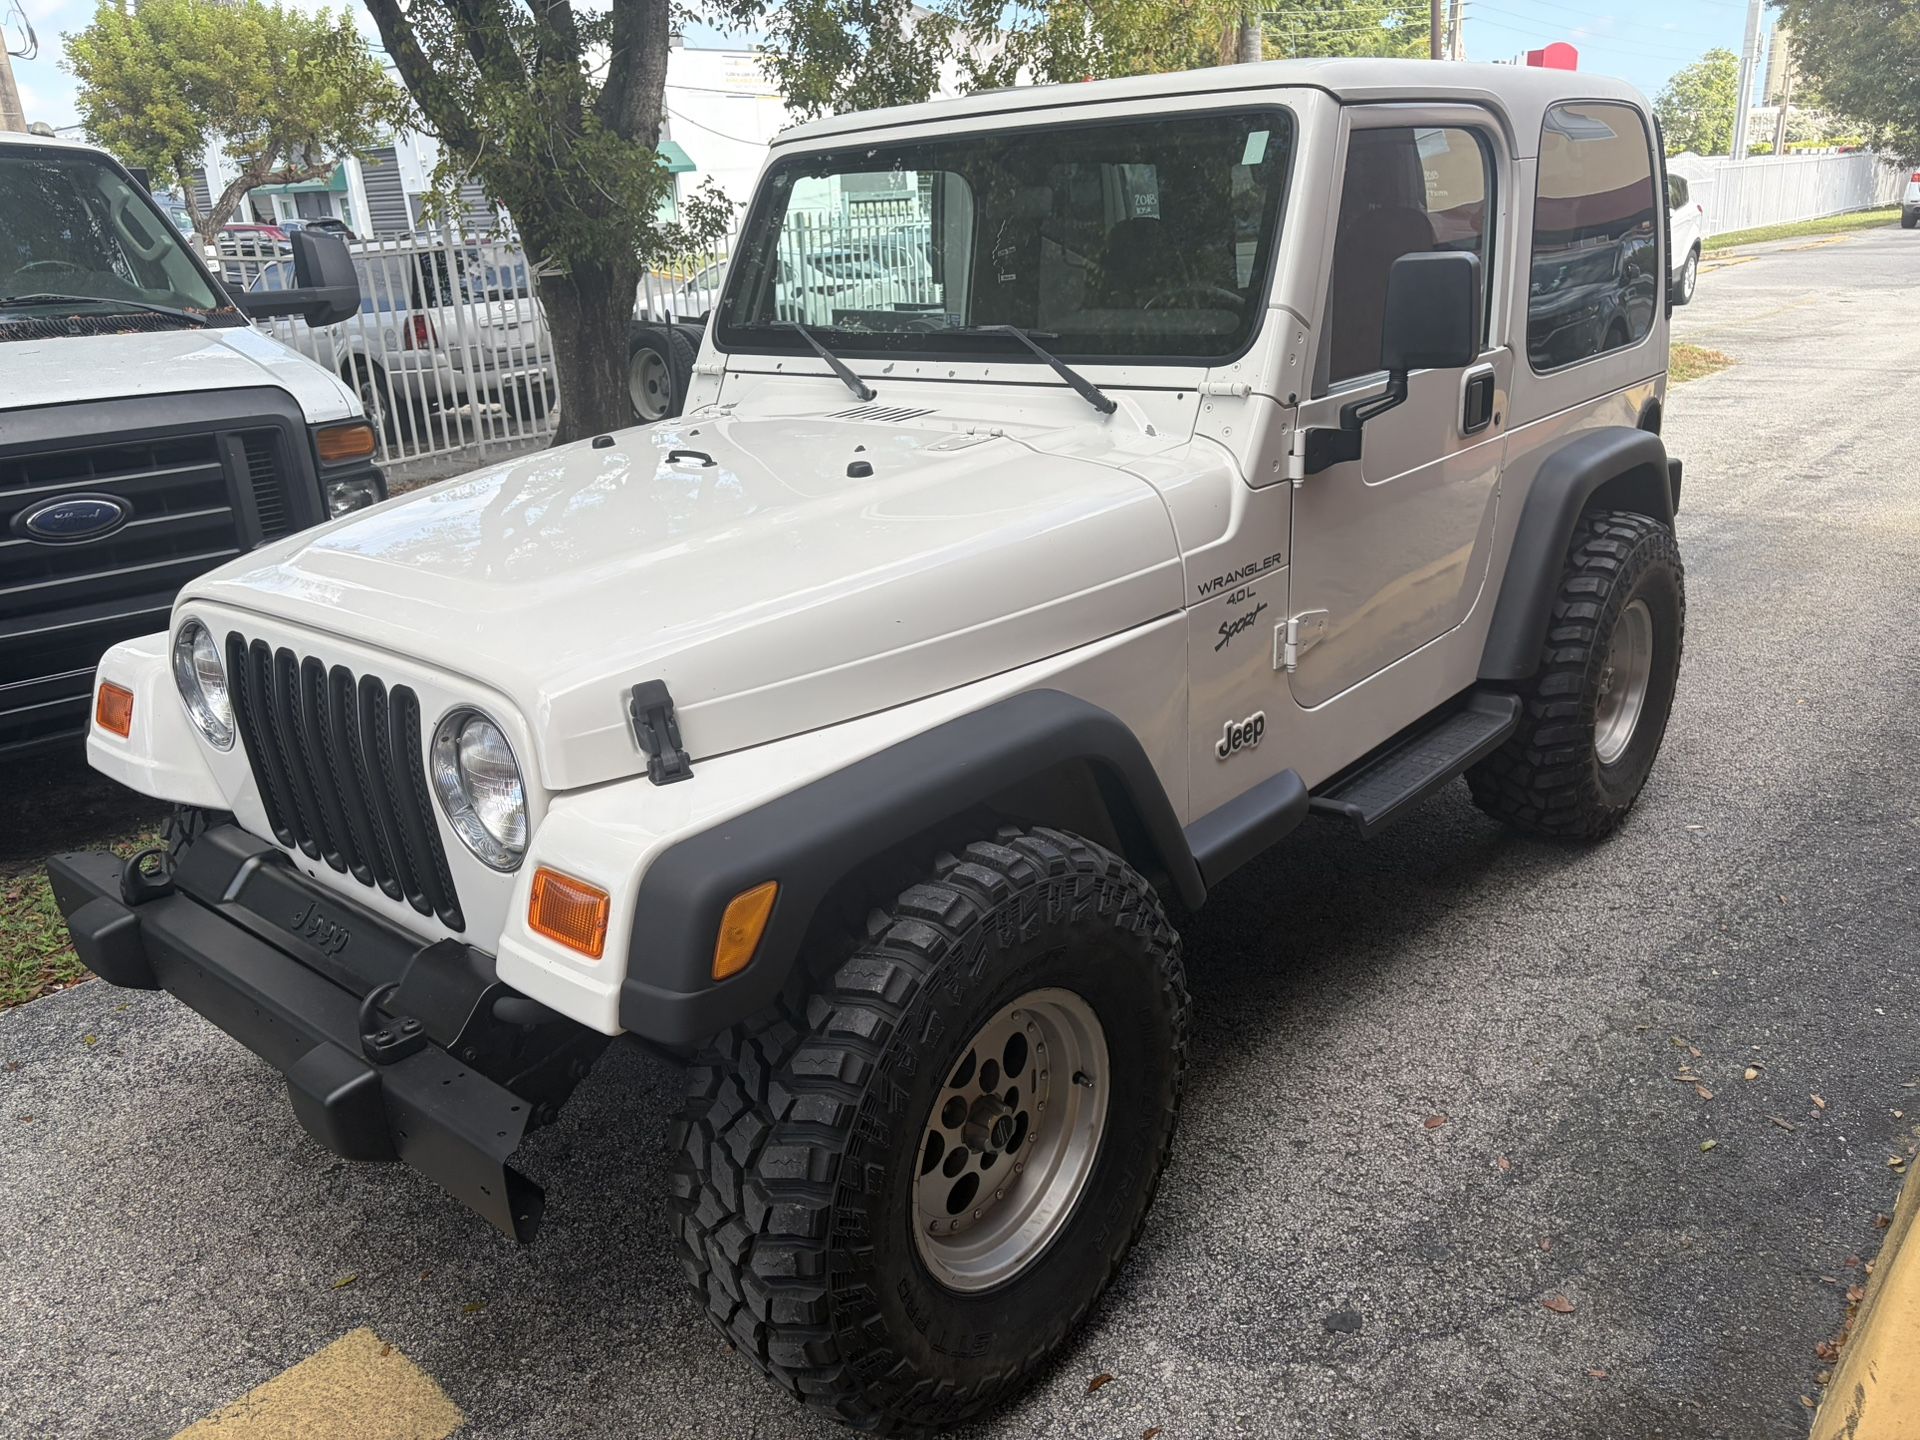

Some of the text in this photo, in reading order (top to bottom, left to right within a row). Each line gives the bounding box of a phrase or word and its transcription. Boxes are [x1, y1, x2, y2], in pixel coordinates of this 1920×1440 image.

[1134, 194, 1157, 206] 2018
[1198, 553, 1281, 595] WRANGLER
[1214, 602, 1268, 652] Sport
[1218, 713, 1265, 758] Jeep
[290, 902, 350, 958] Jeep
